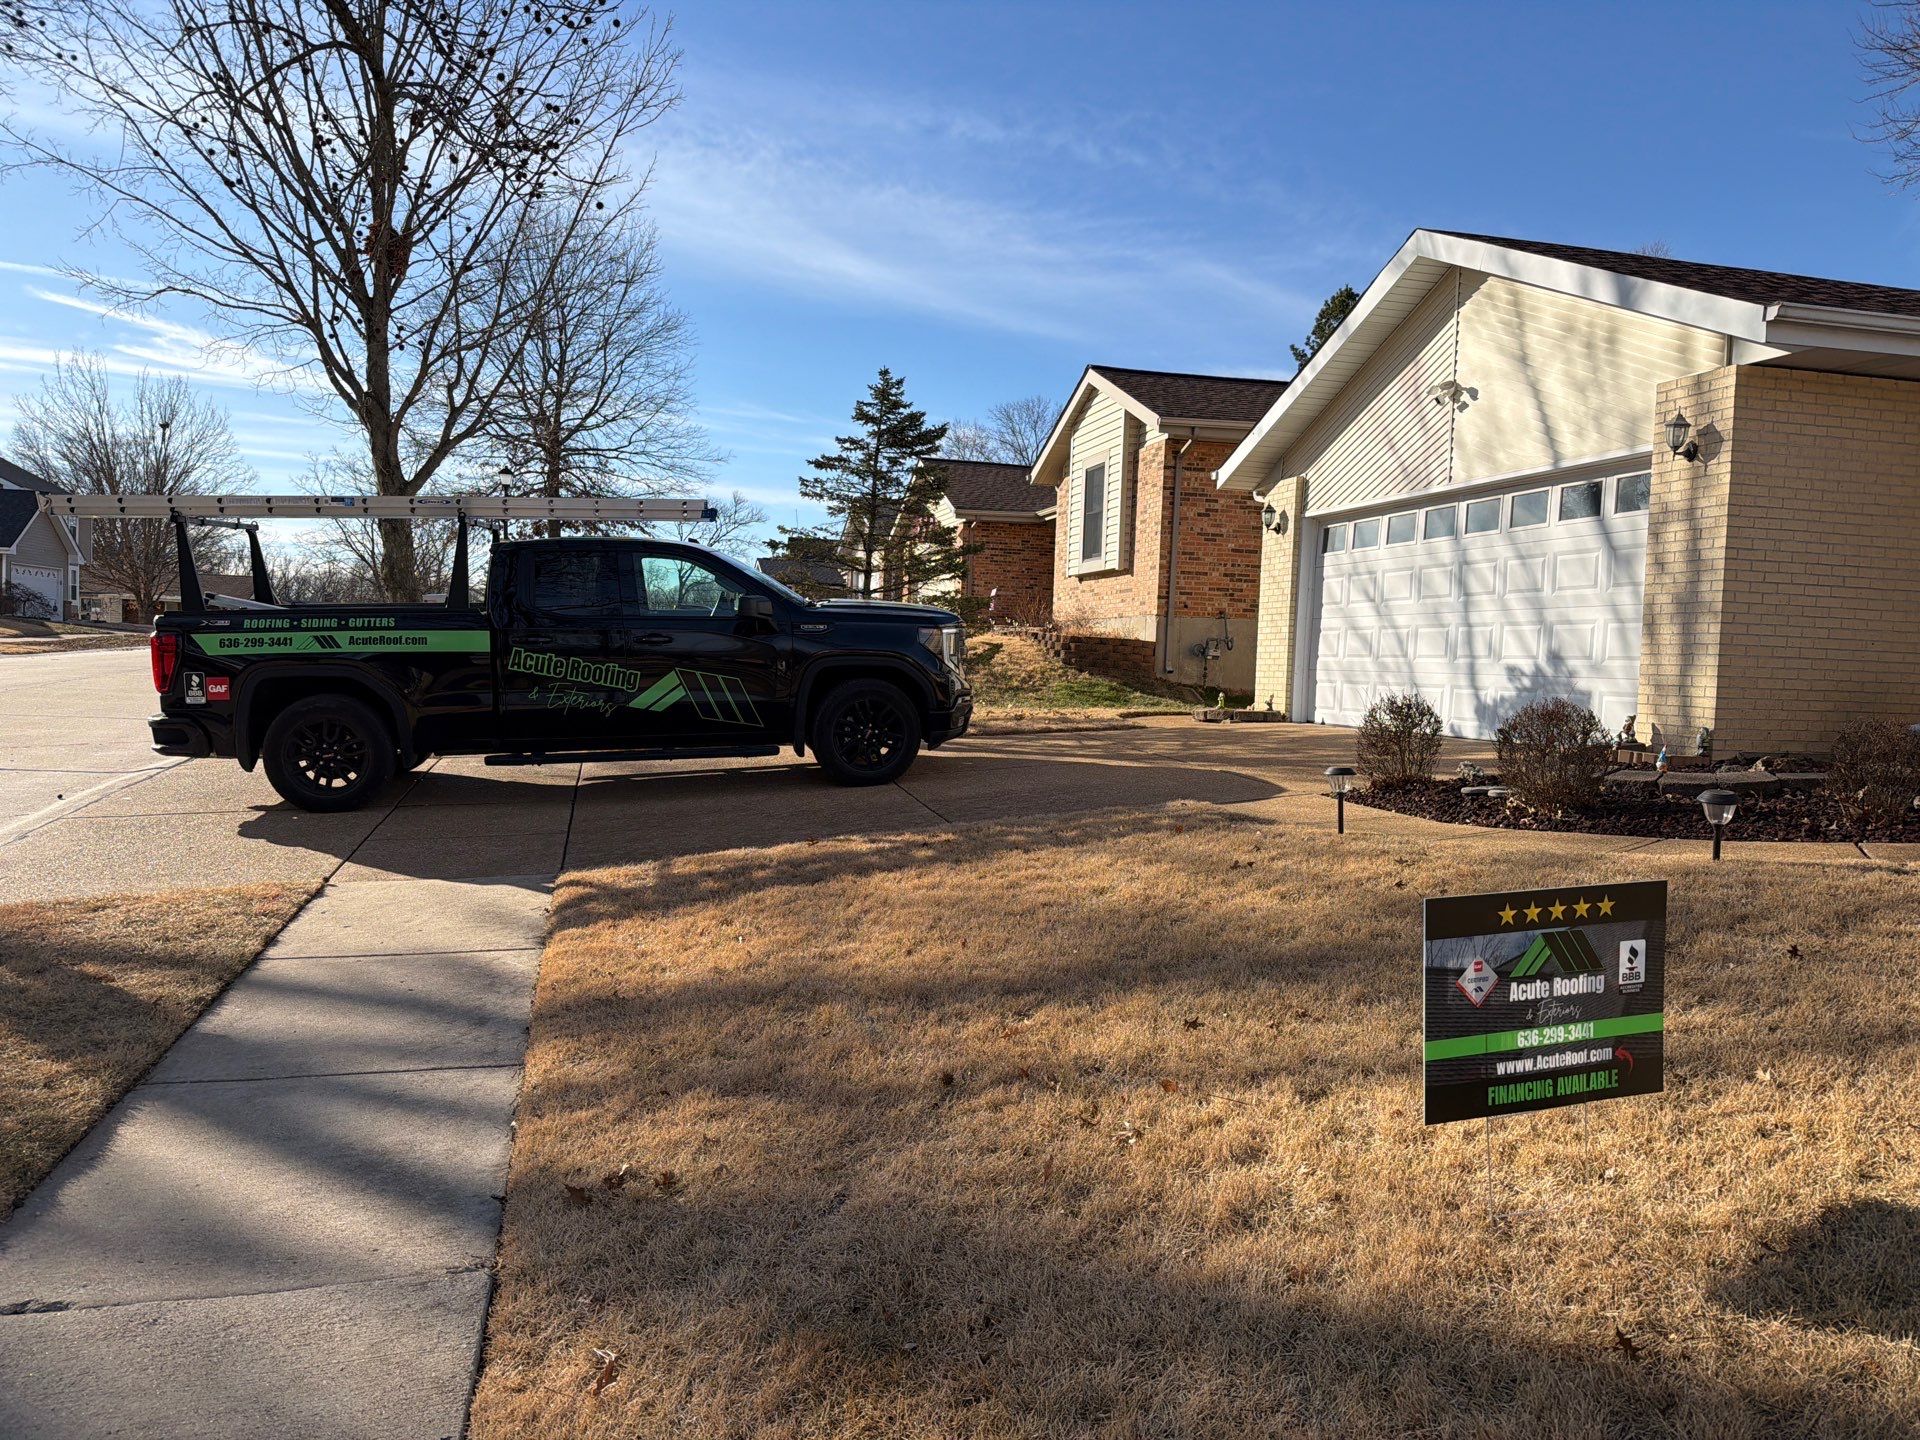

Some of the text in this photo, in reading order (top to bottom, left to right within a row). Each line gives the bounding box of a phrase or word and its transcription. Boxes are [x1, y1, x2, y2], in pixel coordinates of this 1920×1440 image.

[243, 618, 291, 629] ROOFING
[300, 618, 338, 628] SIDING
[348, 617, 396, 628] GUTTERS
[218, 634, 428, 649] 636-299-3441 AcuteRoof.com
[508, 646, 641, 693] Acute Roofing
[208, 684, 228, 693] GAF
[528, 682, 617, 718] & Exteriors
[1509, 972, 1605, 1002] Acute Roofing
[1621, 971, 1641, 982] BBB
[1537, 998, 1583, 1025] Exteriors
[1517, 1022, 1594, 1048] 636-299-3441
[1487, 1069, 1619, 1106] FINANCING AVAILABLE
